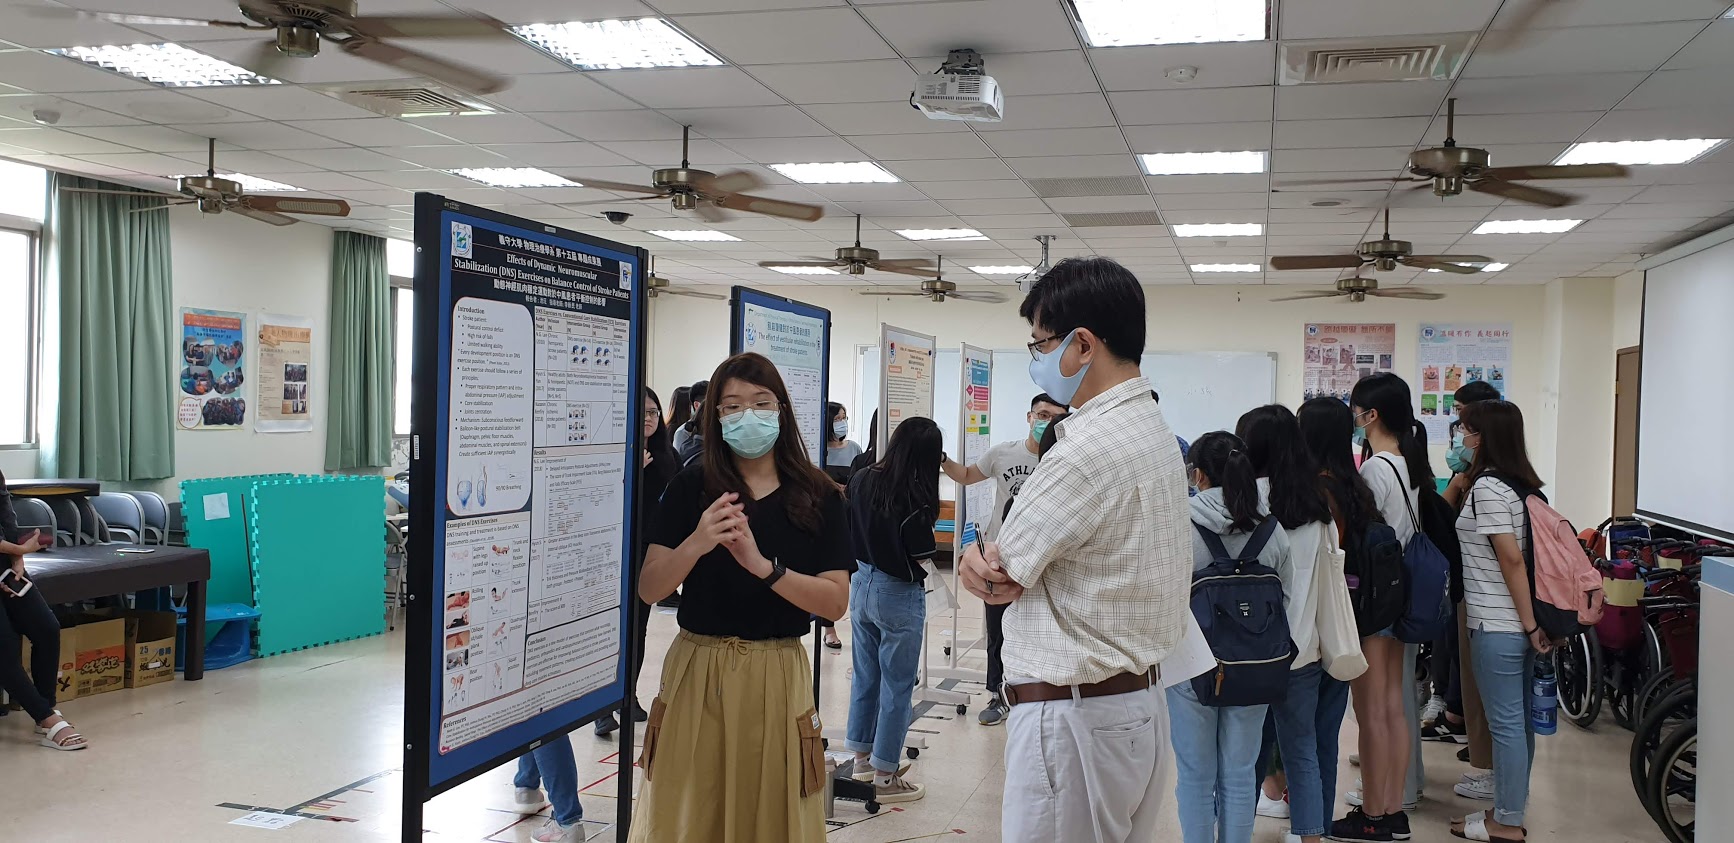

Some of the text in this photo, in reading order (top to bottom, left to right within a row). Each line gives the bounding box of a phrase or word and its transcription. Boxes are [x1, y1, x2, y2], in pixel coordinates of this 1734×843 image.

[507, 254, 597, 280] Effects of Dynamic Neuromuscular
[455, 258, 497, 274] Stabilization
[499, 266, 516, 279] (DNS)
[518, 270, 544, 283] Exercises
[552, 277, 572, 288] Balance
[573, 281, 591, 291] Control
[597, 286, 612, 295] Stroke
[613, 290, 629, 299] Patients
[458, 306, 485, 315] Introduction
[140, 646, 148, 654] 25
[444, 717, 466, 728] References
